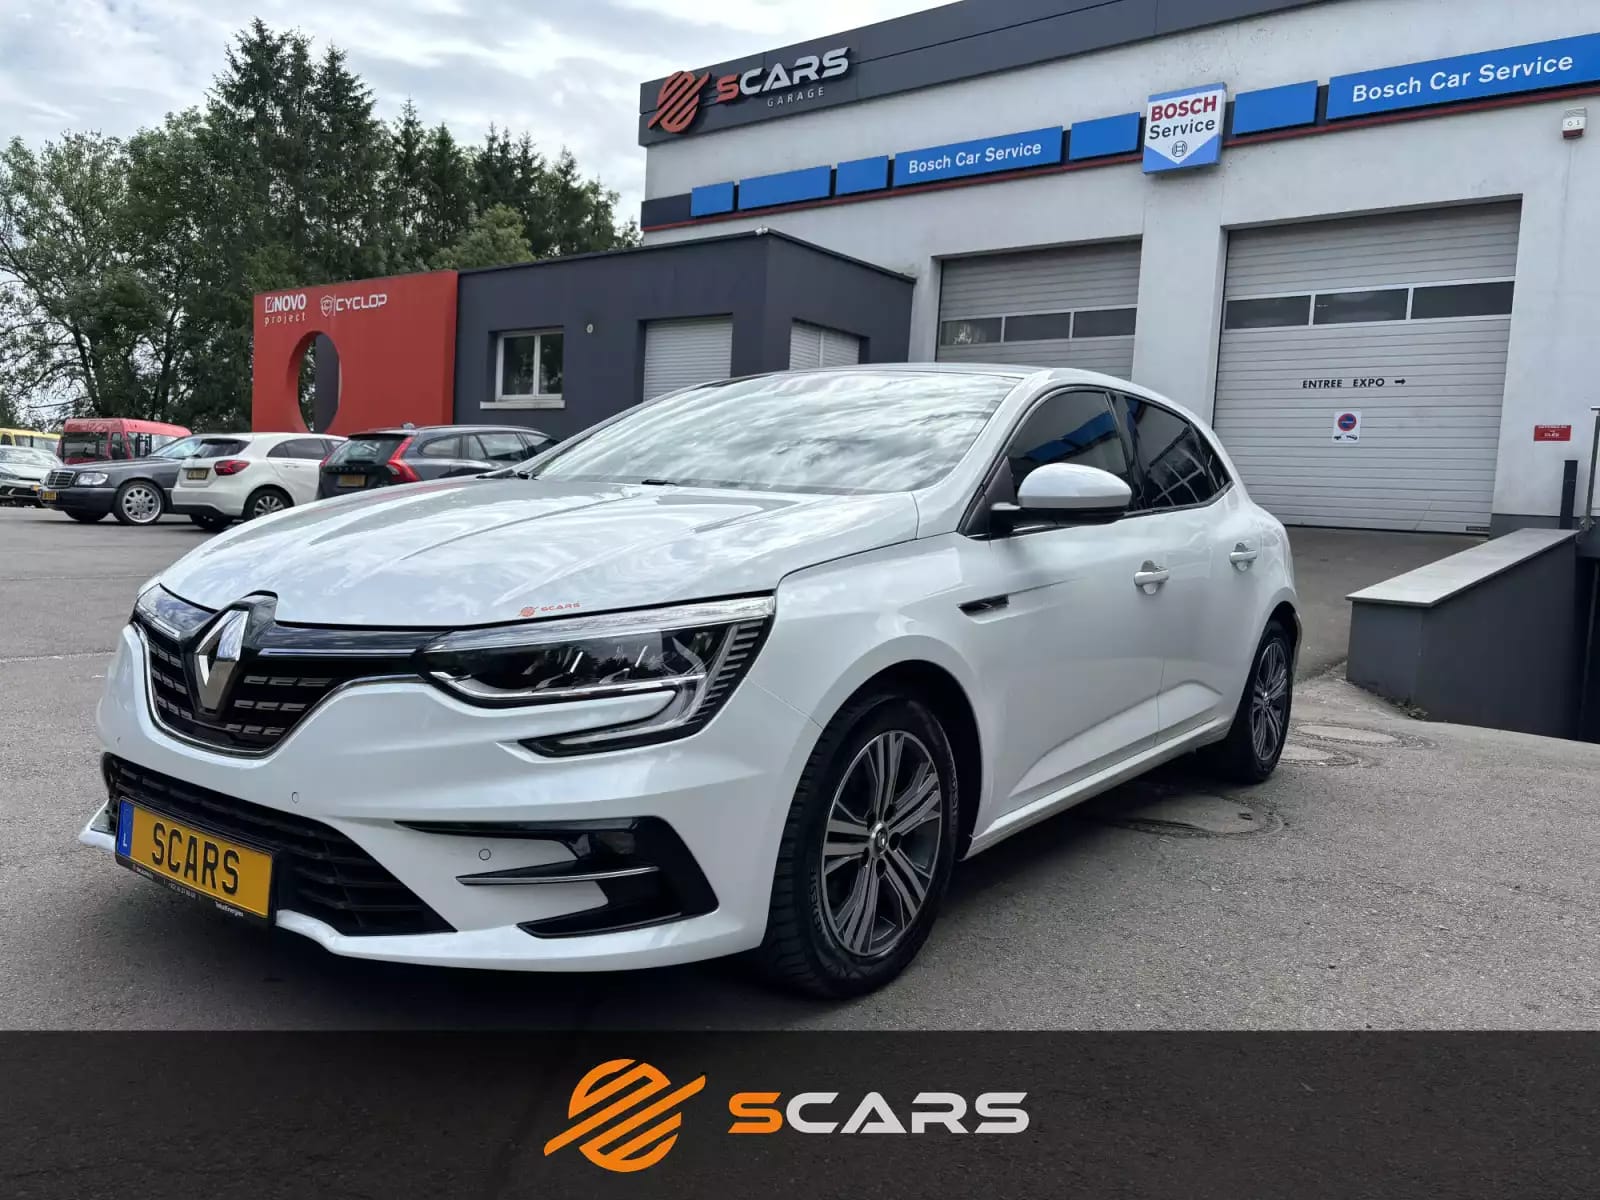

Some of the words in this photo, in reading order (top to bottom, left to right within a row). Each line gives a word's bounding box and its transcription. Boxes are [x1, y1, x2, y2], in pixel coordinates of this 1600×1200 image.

[715, 46, 849, 103] SCARS
[1352, 76, 1421, 103] Bosch
[1430, 71, 1472, 91] Car
[1478, 55, 1574, 83] Service
[767, 87, 825, 107] GARAGE
[1150, 95, 1217, 122] BOSCH
[1148, 116, 1216, 140] Service
[908, 155, 950, 174] Bosch
[955, 150, 980, 166] Car
[985, 141, 1042, 161] Service
[336, 293, 388, 312] CYCLOP
[264, 311, 306, 328] project
[1302, 379, 1343, 389] ENTREE
[1353, 377, 1385, 388] EXPO
[151, 820, 240, 896] SCARS
